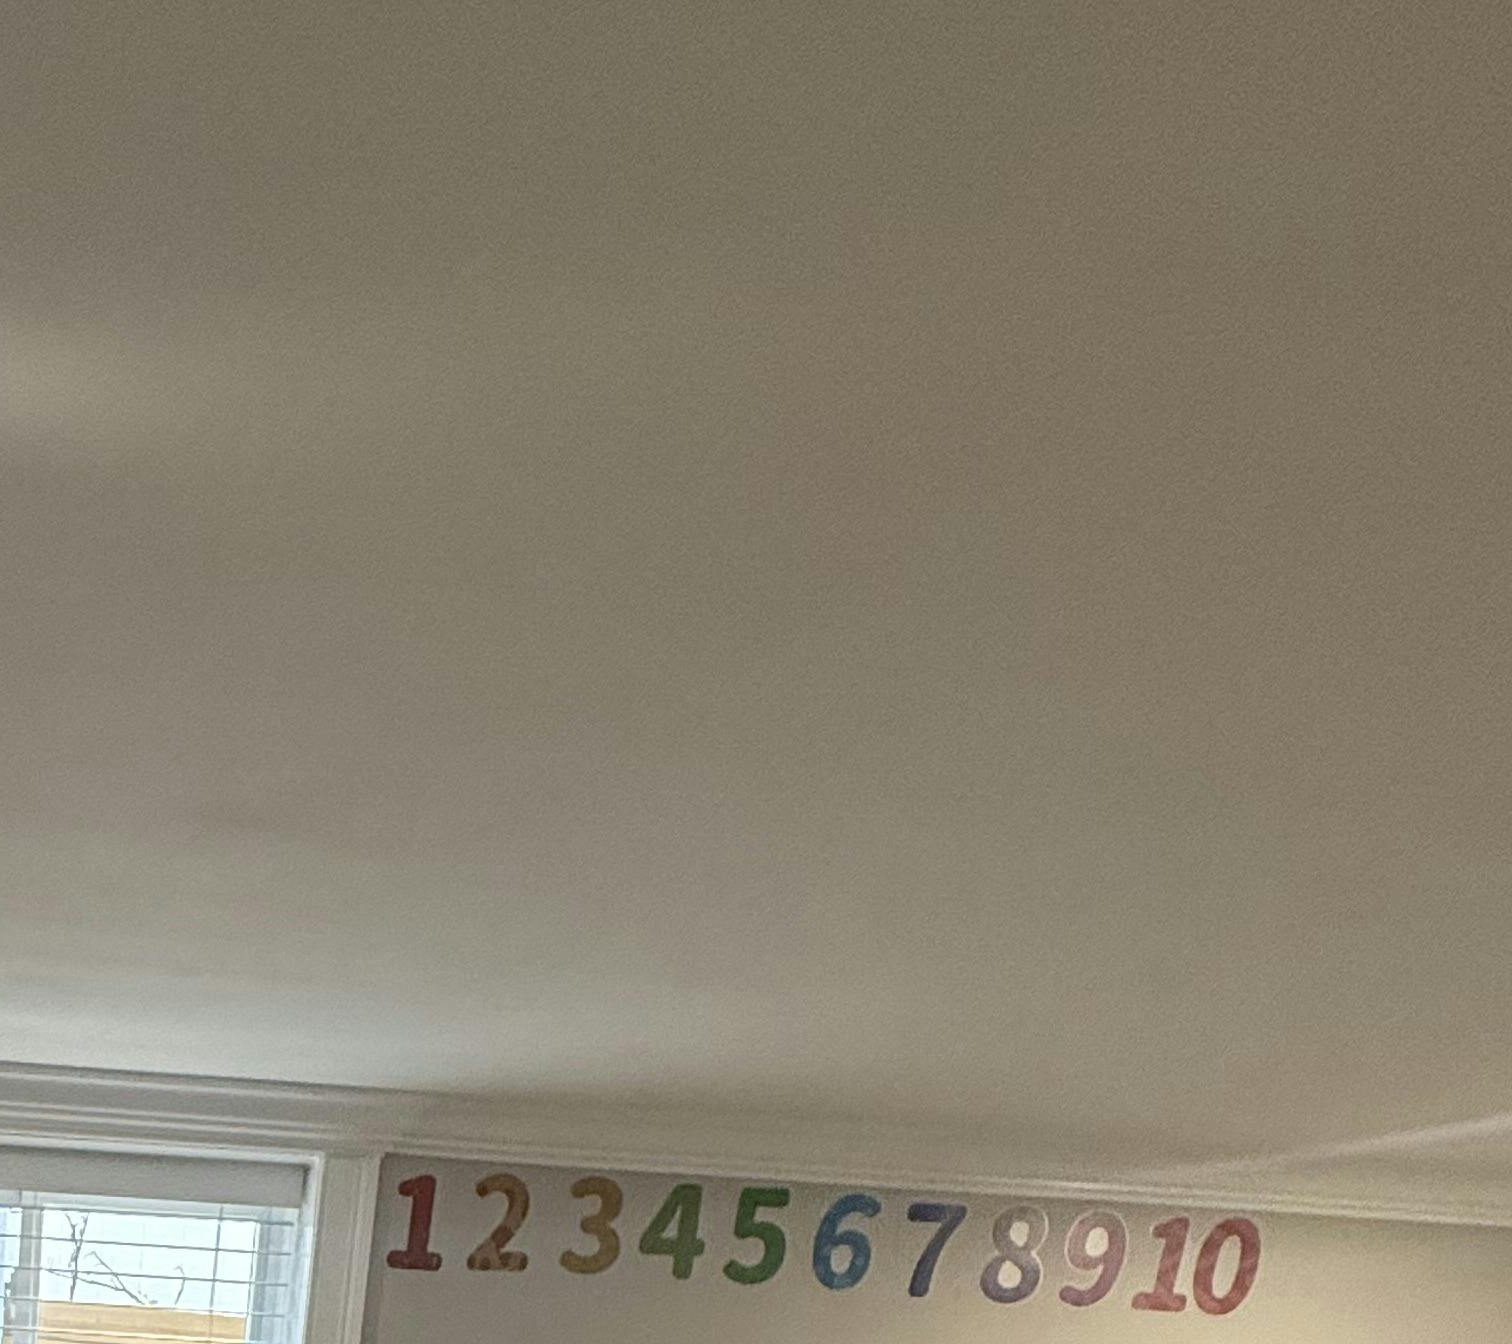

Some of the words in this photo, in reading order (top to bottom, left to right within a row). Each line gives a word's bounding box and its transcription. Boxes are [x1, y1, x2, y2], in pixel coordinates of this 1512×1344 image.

[386, 1173, 443, 1270] 1
[467, 1175, 532, 1273] 2
[559, 1175, 624, 1275] 3
[639, 1183, 706, 1280] 4
[722, 1187, 791, 1285] 5
[812, 1194, 882, 1290] 6
[907, 1202, 967, 1298] 7
[979, 1206, 1050, 1305] 8
[1058, 1212, 1128, 1308] 9
[1130, 1216, 1263, 1316] 10
